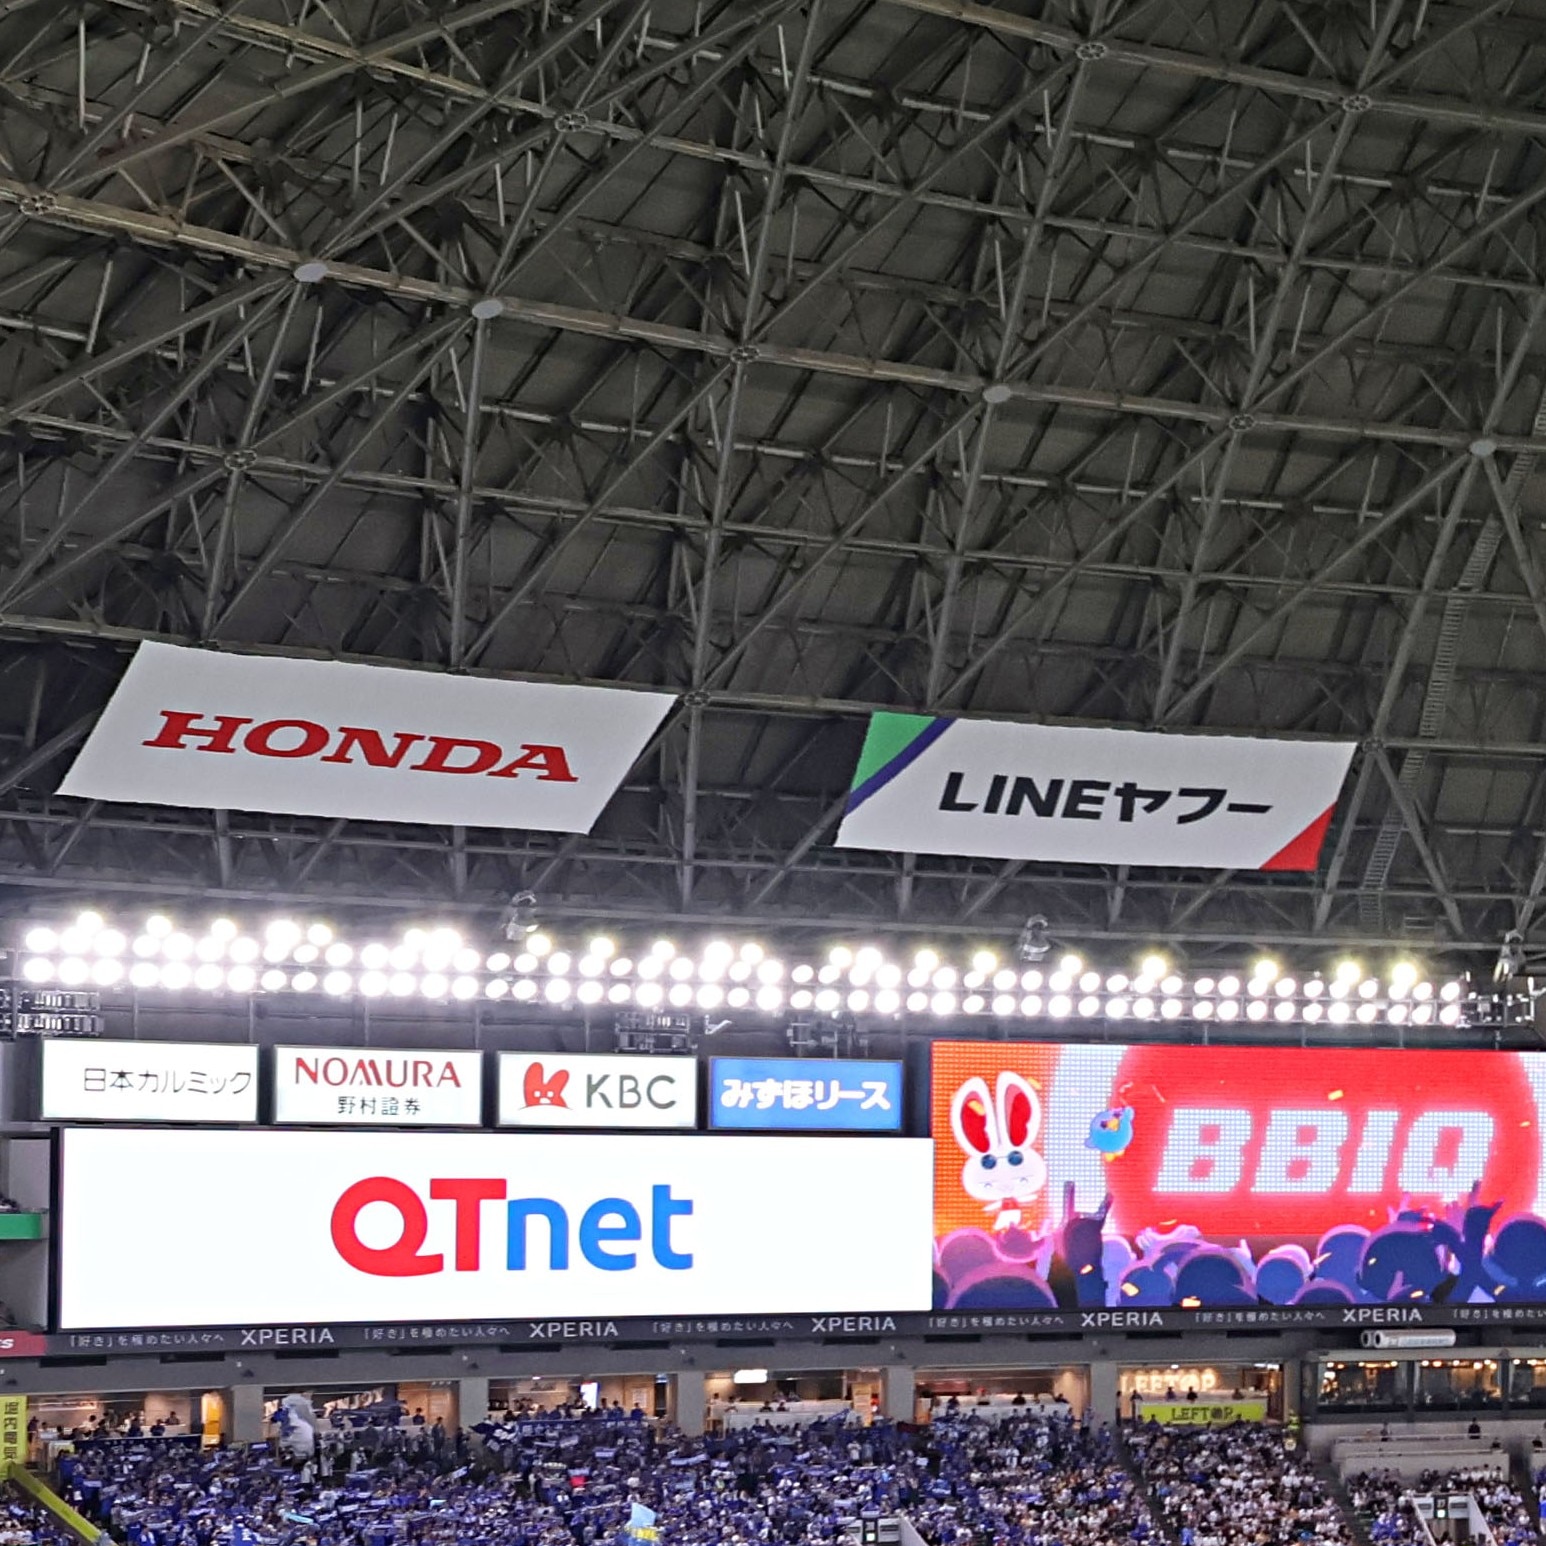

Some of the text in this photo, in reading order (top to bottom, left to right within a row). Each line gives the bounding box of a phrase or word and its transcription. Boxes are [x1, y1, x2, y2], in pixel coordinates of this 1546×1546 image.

[143, 710, 578, 782] HONDA
[938, 771, 1273, 824] LINEヤフー
[84, 1067, 252, 1095] 日本カルミック
[295, 1057, 461, 1087] NOMURA
[585, 1074, 677, 1109] KBC
[720, 1078, 891, 1110] みずほリース
[1153, 1107, 1497, 1197] BBIQ
[331, 1176, 694, 1277] QTnet
[529, 1320, 620, 1338] XPERIA
[811, 1316, 897, 1332] XPERIA
[1080, 1311, 1164, 1327] XPERIA
[1342, 1307, 1423, 1323] XPERIA
[240, 1327, 335, 1345] XPERIA
